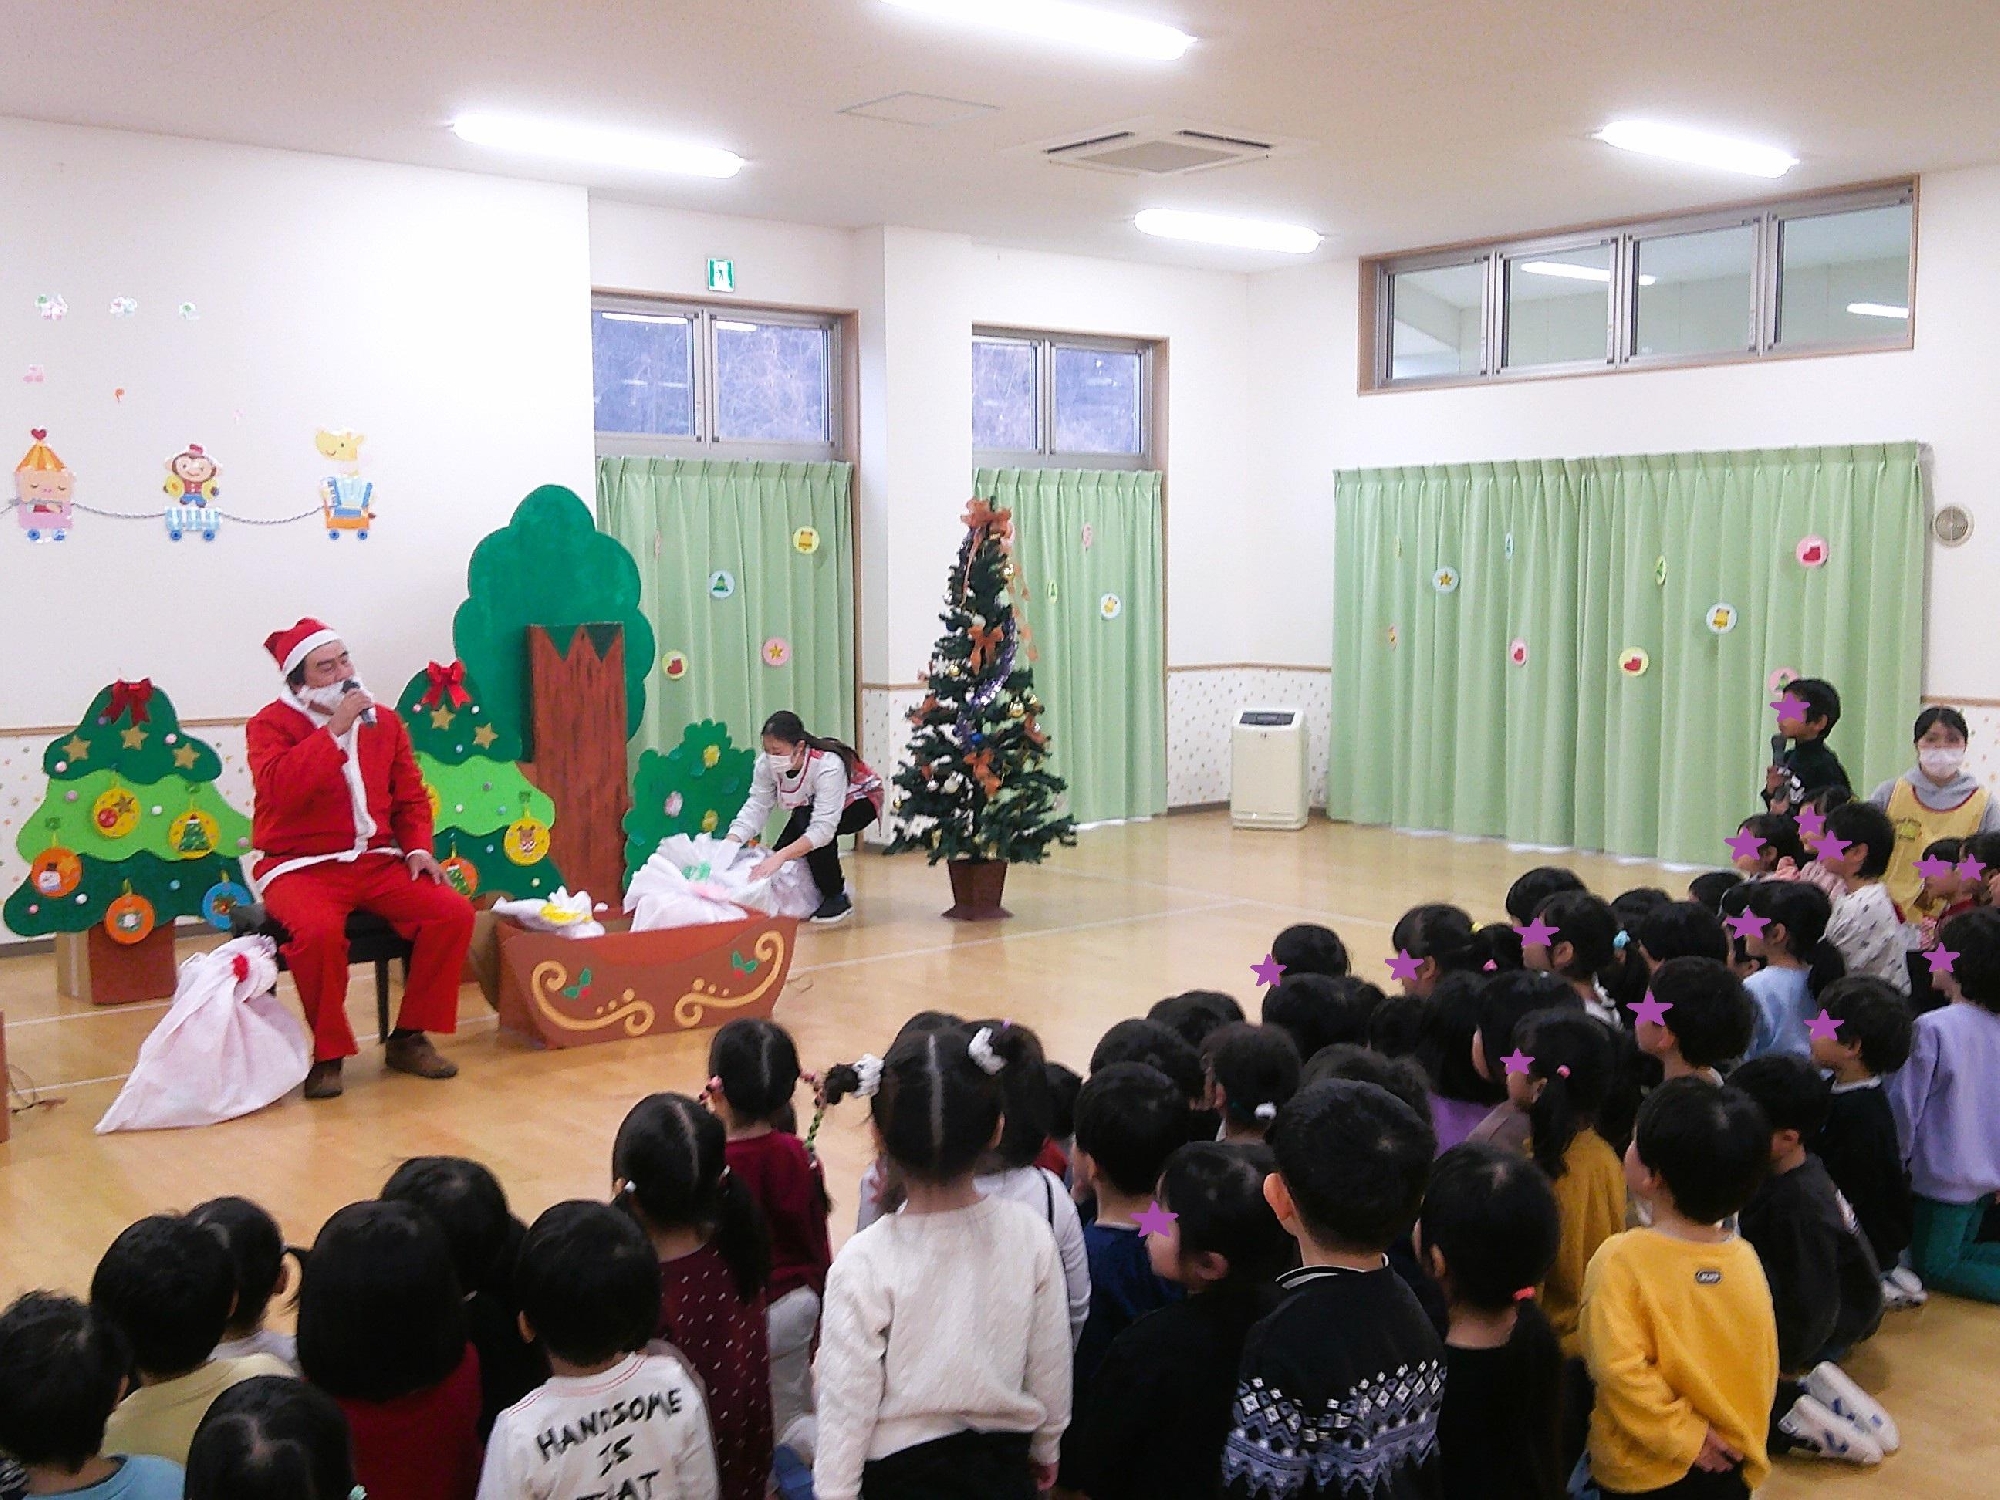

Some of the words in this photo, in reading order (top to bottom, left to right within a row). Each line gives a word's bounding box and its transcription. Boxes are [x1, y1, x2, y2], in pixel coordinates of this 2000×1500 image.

[536, 1387, 682, 1464] HANDSOME
[597, 1433, 634, 1477] IS
[576, 1469, 661, 1500] AT
